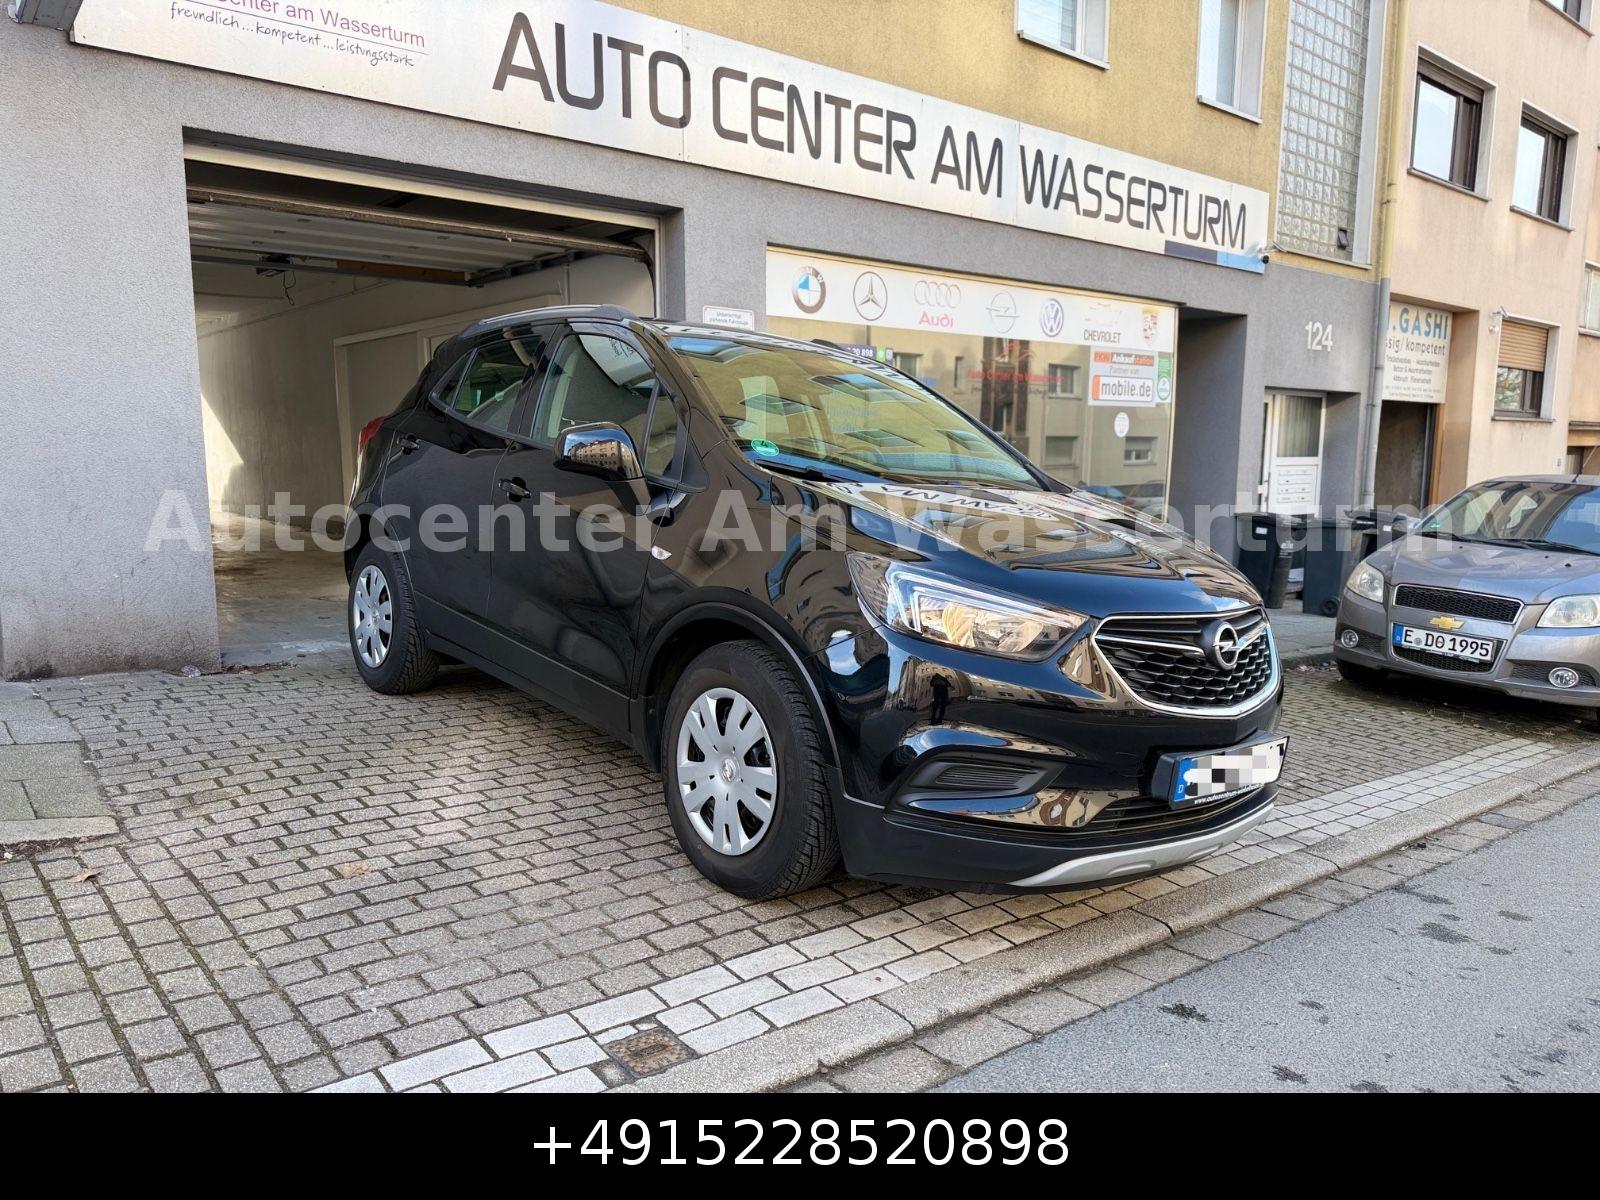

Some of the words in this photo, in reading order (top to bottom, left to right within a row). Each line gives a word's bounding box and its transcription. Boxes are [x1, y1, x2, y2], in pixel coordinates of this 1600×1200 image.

[286, 6, 314, 23] am
[320, 8, 426, 48] Wasserturm
[492, 11, 691, 129] AUTO
[712, 66, 917, 181] CENTER
[930, 125, 1004, 199] AM
[1019, 144, 1247, 251] WASSERTURM
[918, 310, 955, 329] Audi
[1399, 306, 1449, 340] GASHI
[1083, 329, 1122, 345] CHEVROLET
[1305, 321, 1334, 351] 124
[861, 349, 874, 358] 898
[1101, 381, 1151, 397] mobile.de
[1404, 629, 1415, 644] E
[1448, 637, 1490, 657] 1995
